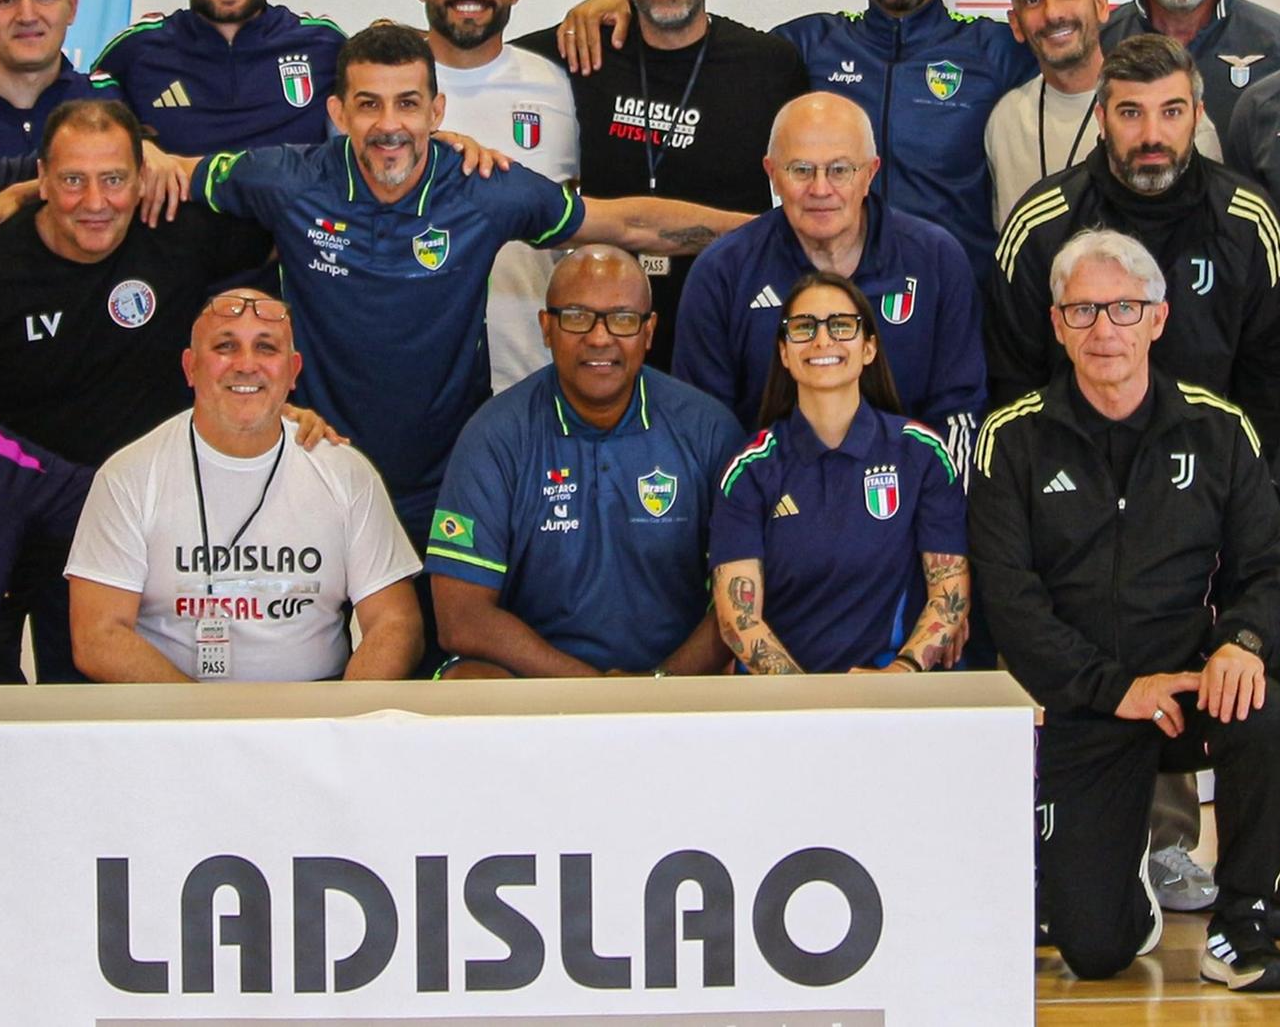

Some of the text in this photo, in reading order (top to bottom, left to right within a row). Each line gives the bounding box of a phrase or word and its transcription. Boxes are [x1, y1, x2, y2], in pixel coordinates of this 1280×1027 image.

[827, 72, 863, 85] Junpe
[307, 228, 350, 246] NOTARO
[308, 258, 349, 277] Junpe
[25, 311, 63, 342] LV
[867, 476, 895, 487] ITALIA
[540, 518, 580, 534] Junpe
[175, 545, 322, 574] LADISLAO
[175, 597, 315, 620] FUTSAL CUP
[202, 660, 225, 674] PASS
[96, 846, 885, 994] LADISLAO
